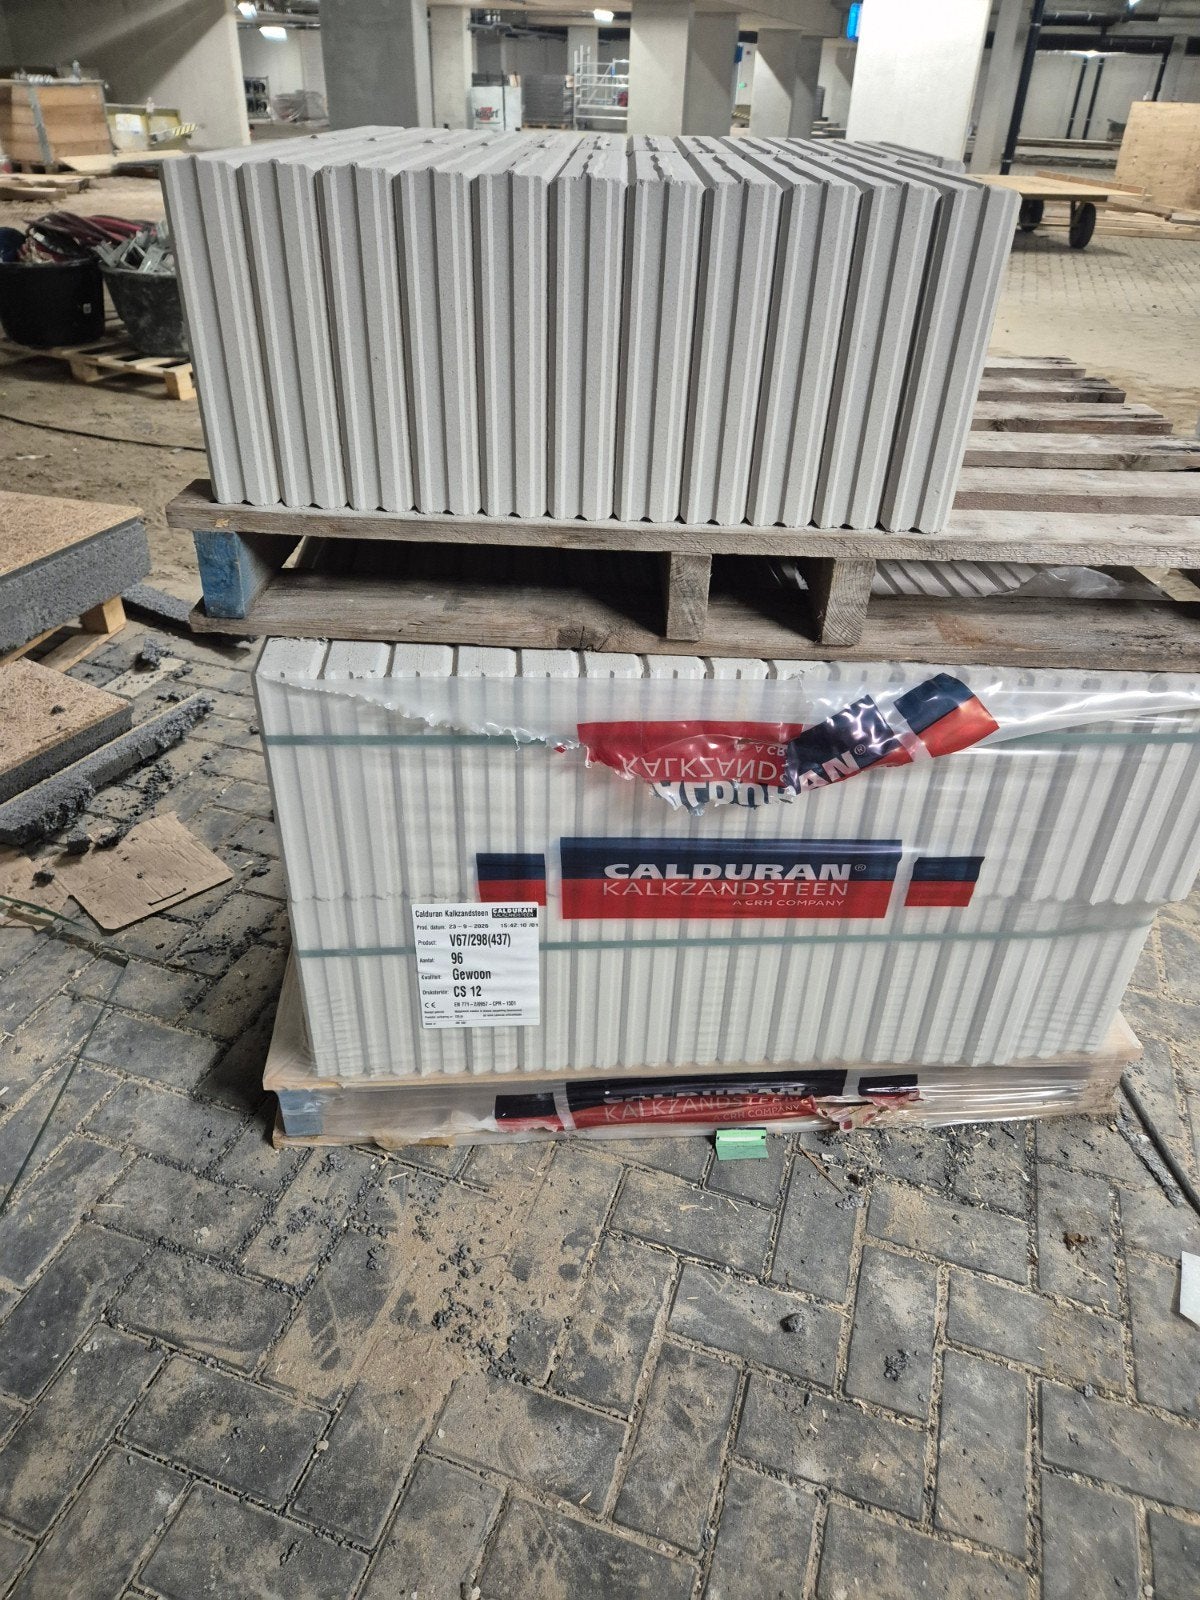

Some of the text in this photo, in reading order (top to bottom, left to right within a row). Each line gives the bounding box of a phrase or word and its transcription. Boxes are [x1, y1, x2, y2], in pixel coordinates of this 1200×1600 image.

[603, 863, 852, 881] CALDURAN
[603, 881, 848, 896] KALKZANDSTEEN
[415, 910, 443, 918] Calduran
[449, 933, 511, 948] V67/298(437)
[451, 952, 463, 964] 96
[452, 968, 491, 980] Gewoon
[453, 985, 466, 997] CS
[470, 985, 482, 997] 12
[747, 1104, 800, 1118] COMPANY
